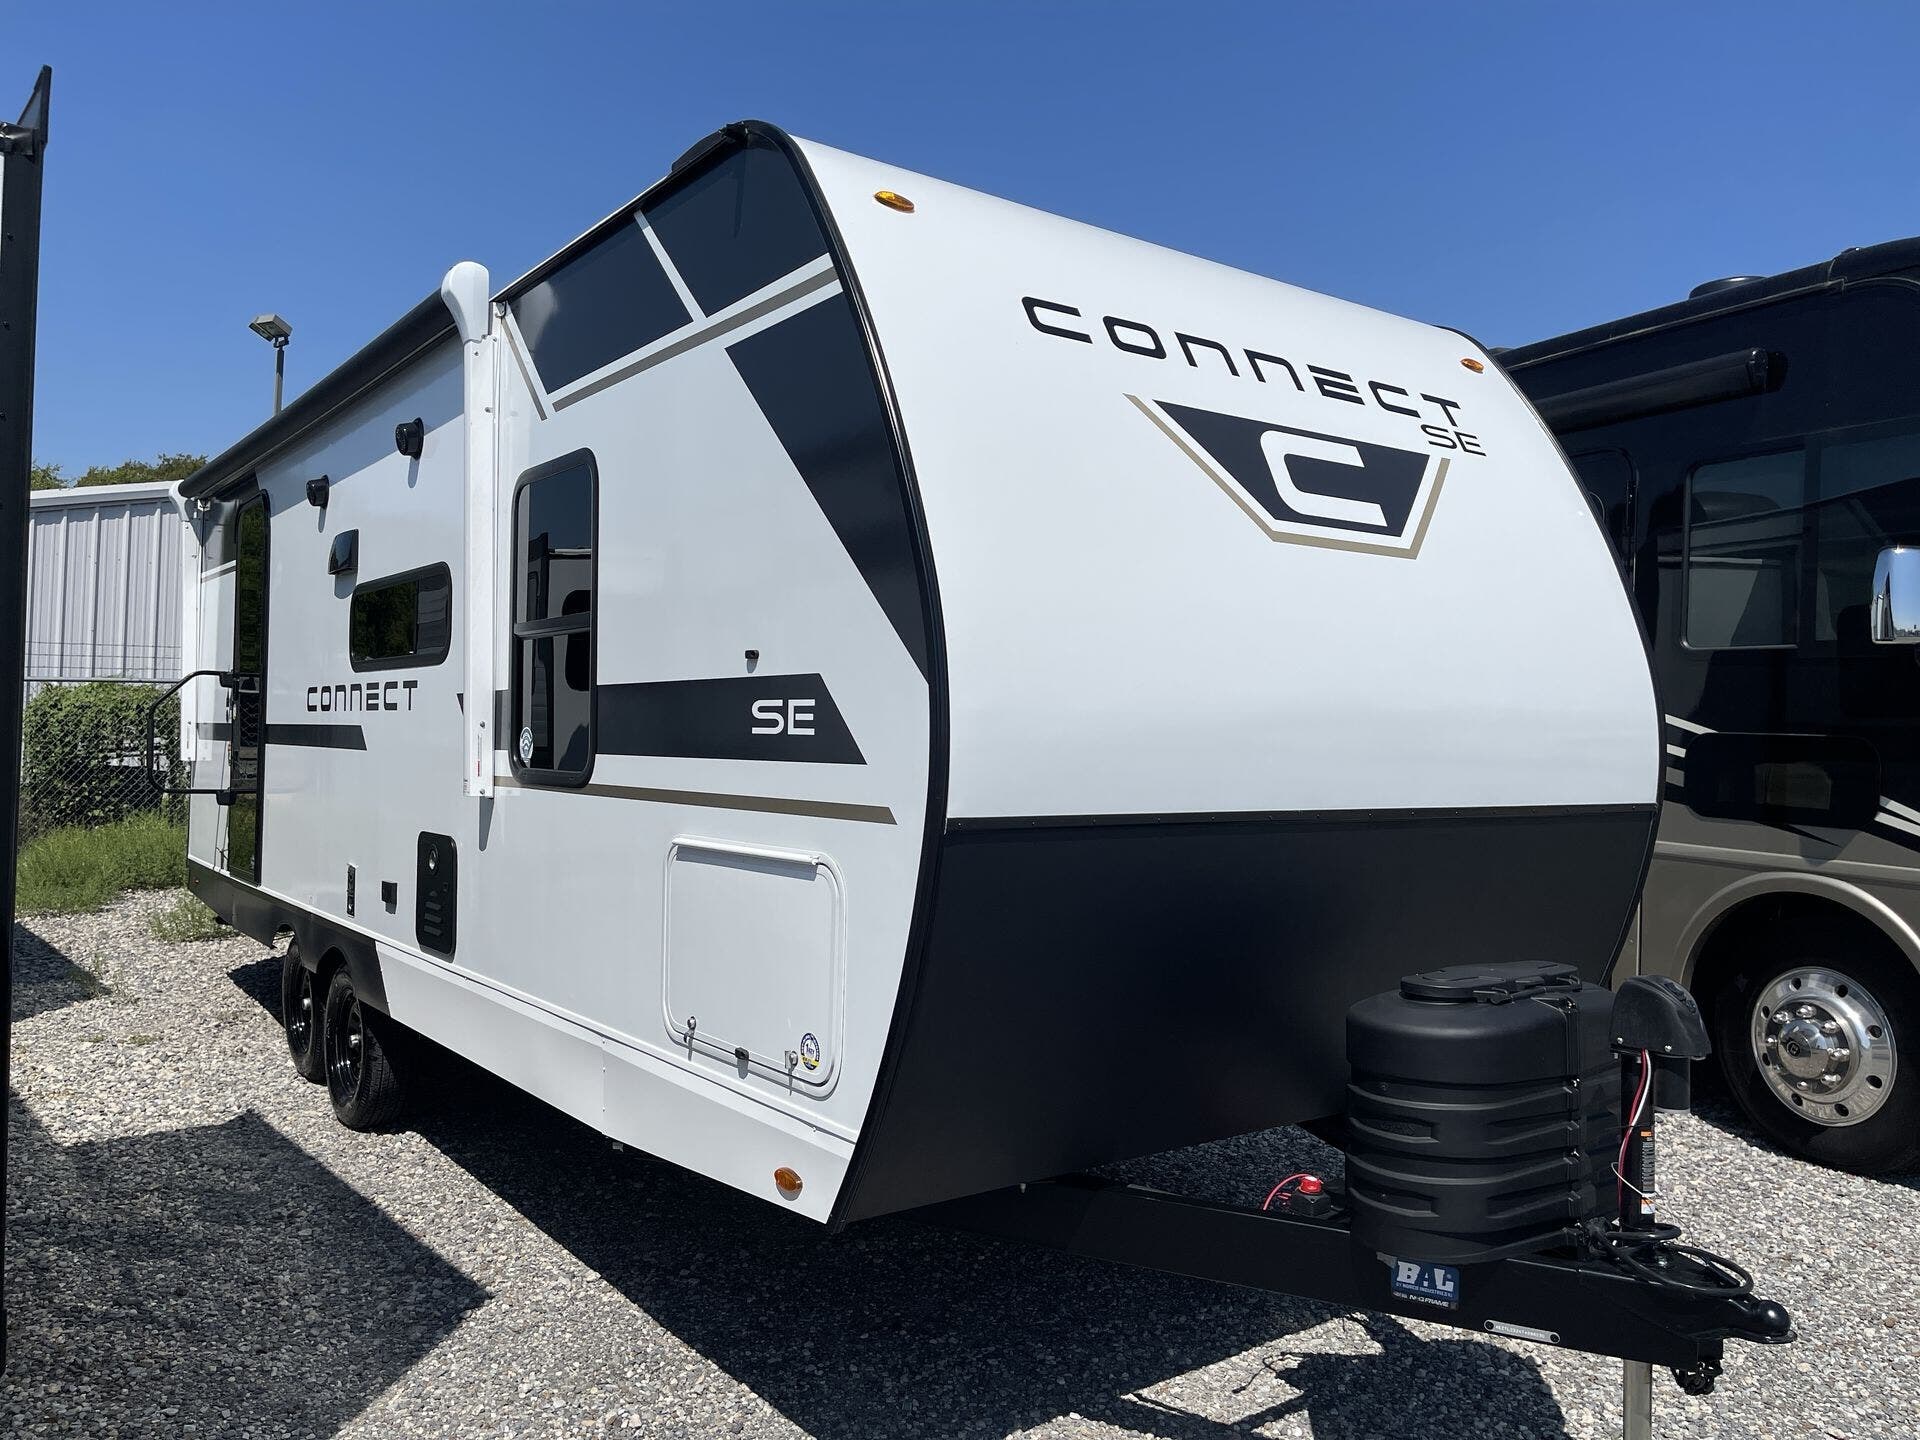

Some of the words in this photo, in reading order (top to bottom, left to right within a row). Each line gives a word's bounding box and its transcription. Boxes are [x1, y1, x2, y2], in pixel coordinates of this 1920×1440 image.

[1021, 296, 1461, 428] CONNECT
[1420, 424, 1487, 457] SE
[307, 680, 418, 712] CONNECT
[751, 699, 816, 736] SE
[1397, 1261, 1454, 1292] BAL
